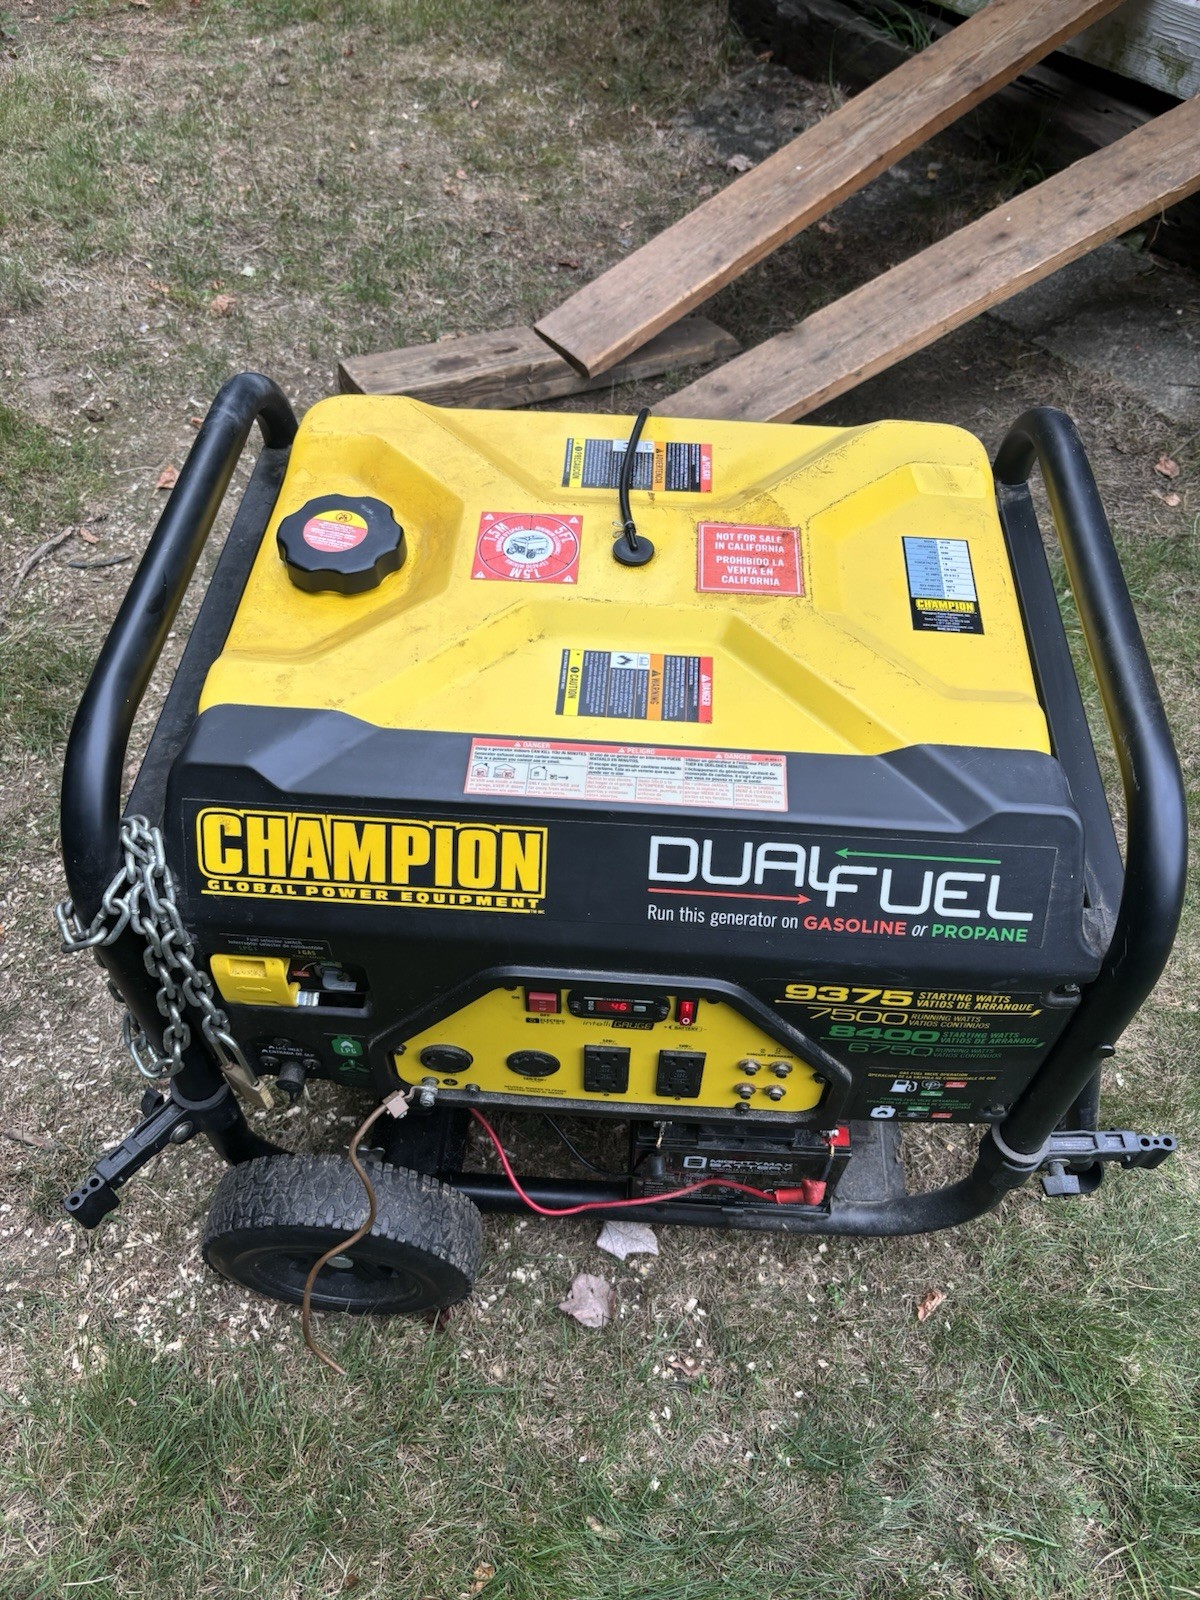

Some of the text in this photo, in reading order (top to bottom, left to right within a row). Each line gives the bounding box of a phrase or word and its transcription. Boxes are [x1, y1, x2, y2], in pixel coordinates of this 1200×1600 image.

[716, 532, 783, 544] NOT FOR SALE
[715, 542, 785, 553] IN CALIFORNIA
[716, 555, 784, 567] PROHIBIDO LA
[727, 565, 774, 576] VENTA EN
[721, 575, 780, 586] CALIFORNIA
[915, 599, 975, 614] CHAMPION
[568, 674, 579, 699] CAUTION
[650, 679, 660, 706] WARNING
[522, 741, 550, 749] DANGER
[723, 752, 752, 760] DANGER
[200, 811, 542, 894] CHAMPION
[207, 880, 539, 909] GLOBAL POWER EQUIPMENT
[647, 904, 1028, 943] Run this generator on GASOLINE or PROPANE
[785, 984, 914, 1007] 9375
[918, 991, 1011, 1003] STARTING WATTS
[610, 1002, 626, 1010] 46
[916, 998, 1035, 1011] VATIOS DE ARRANQUE
[807, 1006, 908, 1025] 7500
[910, 1012, 981, 1022] RUNNING WATTS
[908, 1018, 990, 1029] VATIOS CONTINUOS
[828, 1025, 941, 1042] 8400
[940, 1035, 1039, 1044] VATIOS DE ARRANQUE
[941, 1030, 1020, 1039] STARTING WATTS
[338, 1046, 356, 1054] LPG
[847, 1042, 934, 1057] 6750
[934, 1046, 969, 1054] RUNNING
